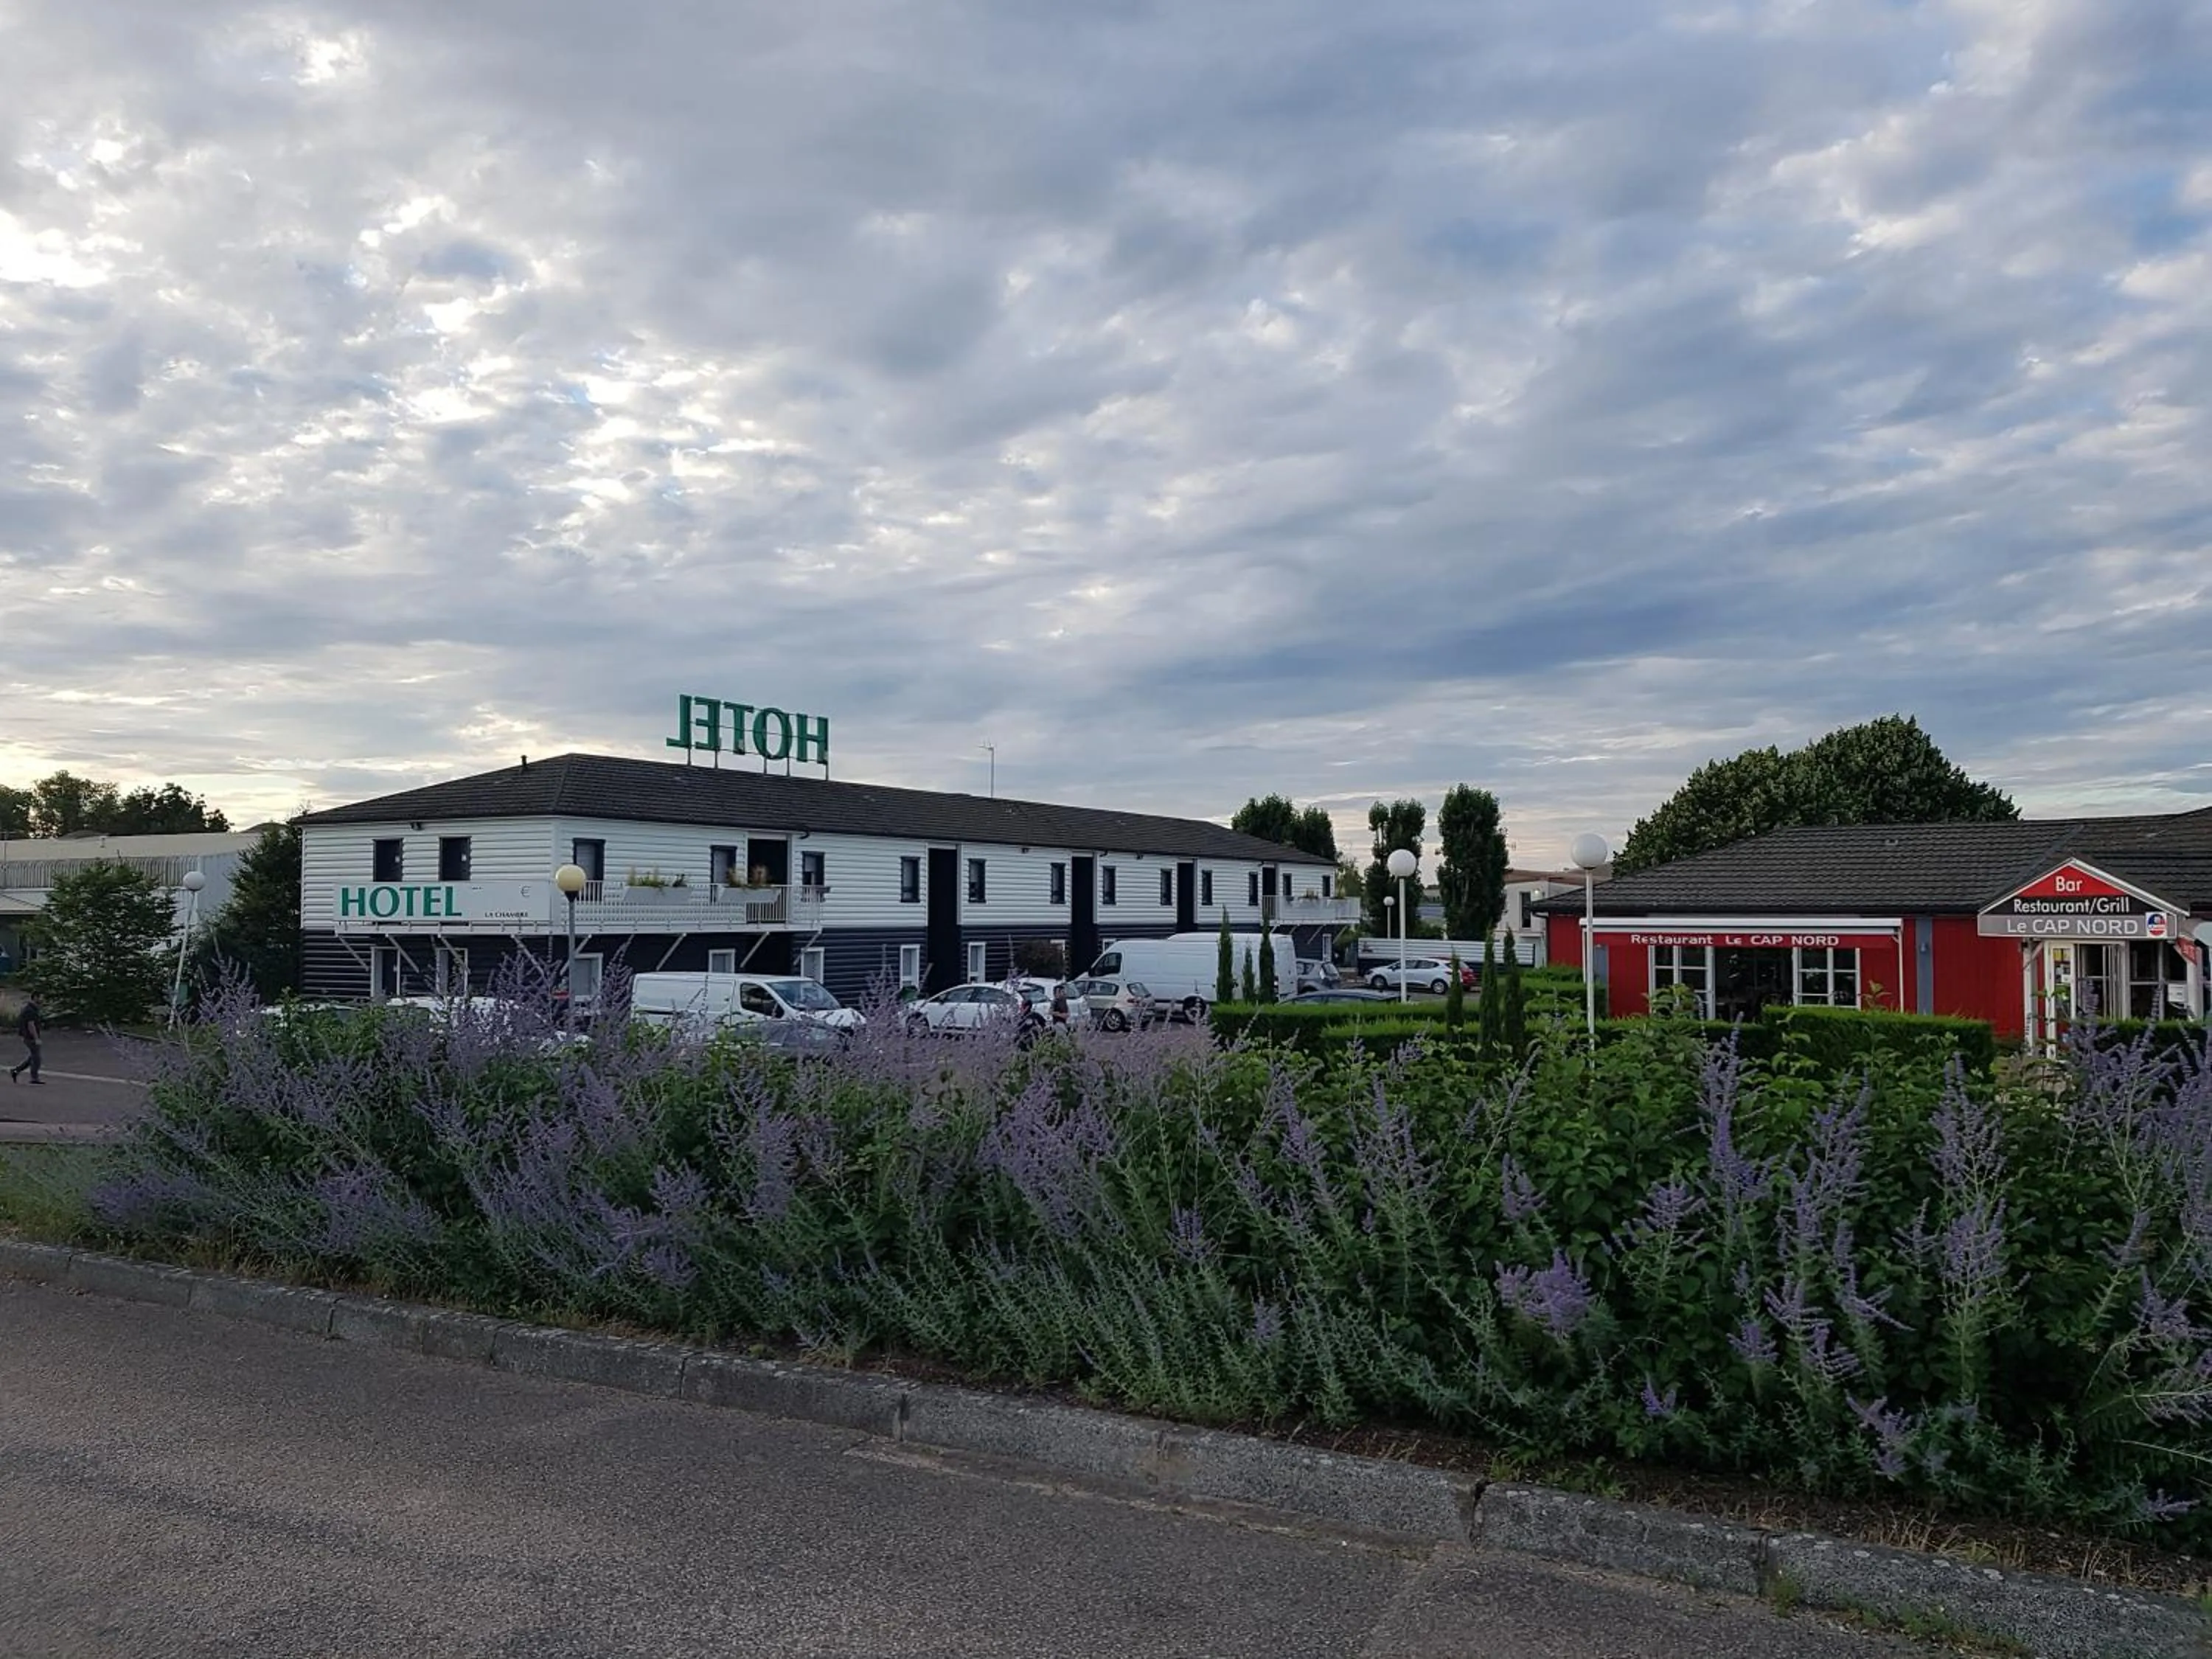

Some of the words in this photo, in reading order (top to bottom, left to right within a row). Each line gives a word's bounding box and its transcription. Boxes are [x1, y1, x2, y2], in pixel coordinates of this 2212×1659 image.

[2055, 876, 2083, 892] Bar
[341, 886, 462, 917] HOTEL
[2013, 897, 2130, 914] Restaurant/Grill
[2006, 919, 2028, 933] Le
[2032, 919, 2070, 933] CAP
[2076, 919, 2138, 935] NORD
[1630, 934, 1714, 945] Restaurant
[1725, 934, 1742, 945] Le
[1750, 935, 1783, 945] CAP
[1791, 935, 1840, 946] NORD
